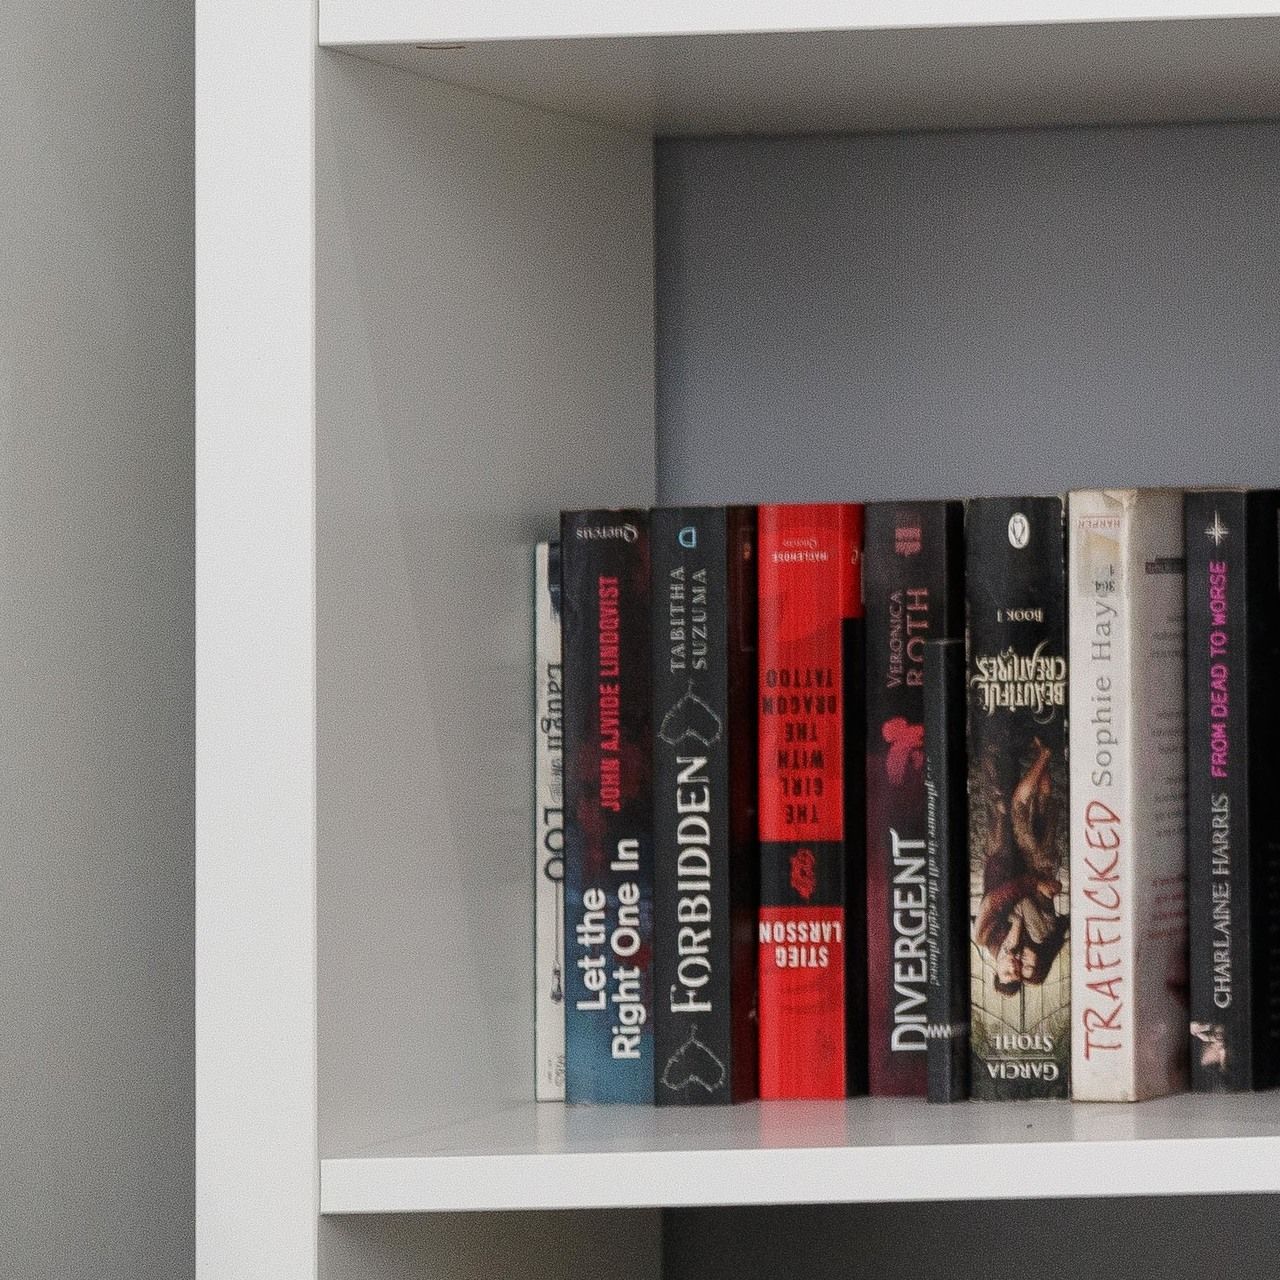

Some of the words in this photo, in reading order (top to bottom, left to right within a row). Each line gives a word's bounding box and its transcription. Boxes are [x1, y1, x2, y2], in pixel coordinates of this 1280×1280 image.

[576, 523, 639, 543] Quercus
[670, 566, 686, 674] TABITHA
[692, 568, 707, 670] SUZUMA
[1006, 608, 1044, 622] BOOK
[1209, 560, 1229, 626] WORSE
[599, 576, 620, 676] LINDQVIST
[886, 589, 903, 688] VERONICA
[906, 588, 928, 687] ROTH
[1091, 592, 1118, 661] Hay
[1209, 630, 1228, 658] TO
[766, 669, 834, 688] TATTOO
[970, 640, 1066, 687] CREATURES
[1210, 664, 1229, 718] DEAD
[600, 683, 621, 751] AJVIDE
[762, 695, 837, 715] DRAGON
[977, 682, 1066, 724] BEAUTIFUL
[1091, 677, 1118, 786] Sophie
[777, 749, 824, 770] WITH
[786, 722, 818, 742] THE
[1210, 722, 1229, 779] FROM
[600, 758, 622, 812] JOHN
[782, 776, 823, 797] GIRL
[786, 803, 818, 825] THE
[1211, 792, 1230, 875] HARRIS
[610, 838, 640, 871] In
[670, 756, 712, 1013] FORBIDDEN
[576, 887, 607, 946] the
[610, 882, 641, 957] One
[759, 921, 842, 944] LARSSON
[889, 827, 928, 1051] DIVERGENT
[1083, 800, 1123, 1061] TRAFFICKED
[775, 945, 829, 968] STIEG
[1212, 882, 1232, 1009] CHARLAINE
[576, 954, 607, 1011] Let
[612, 966, 647, 1059] Right
[987, 1061, 1059, 1081] GARCIA
[992, 1033, 1054, 1052] STOHL
